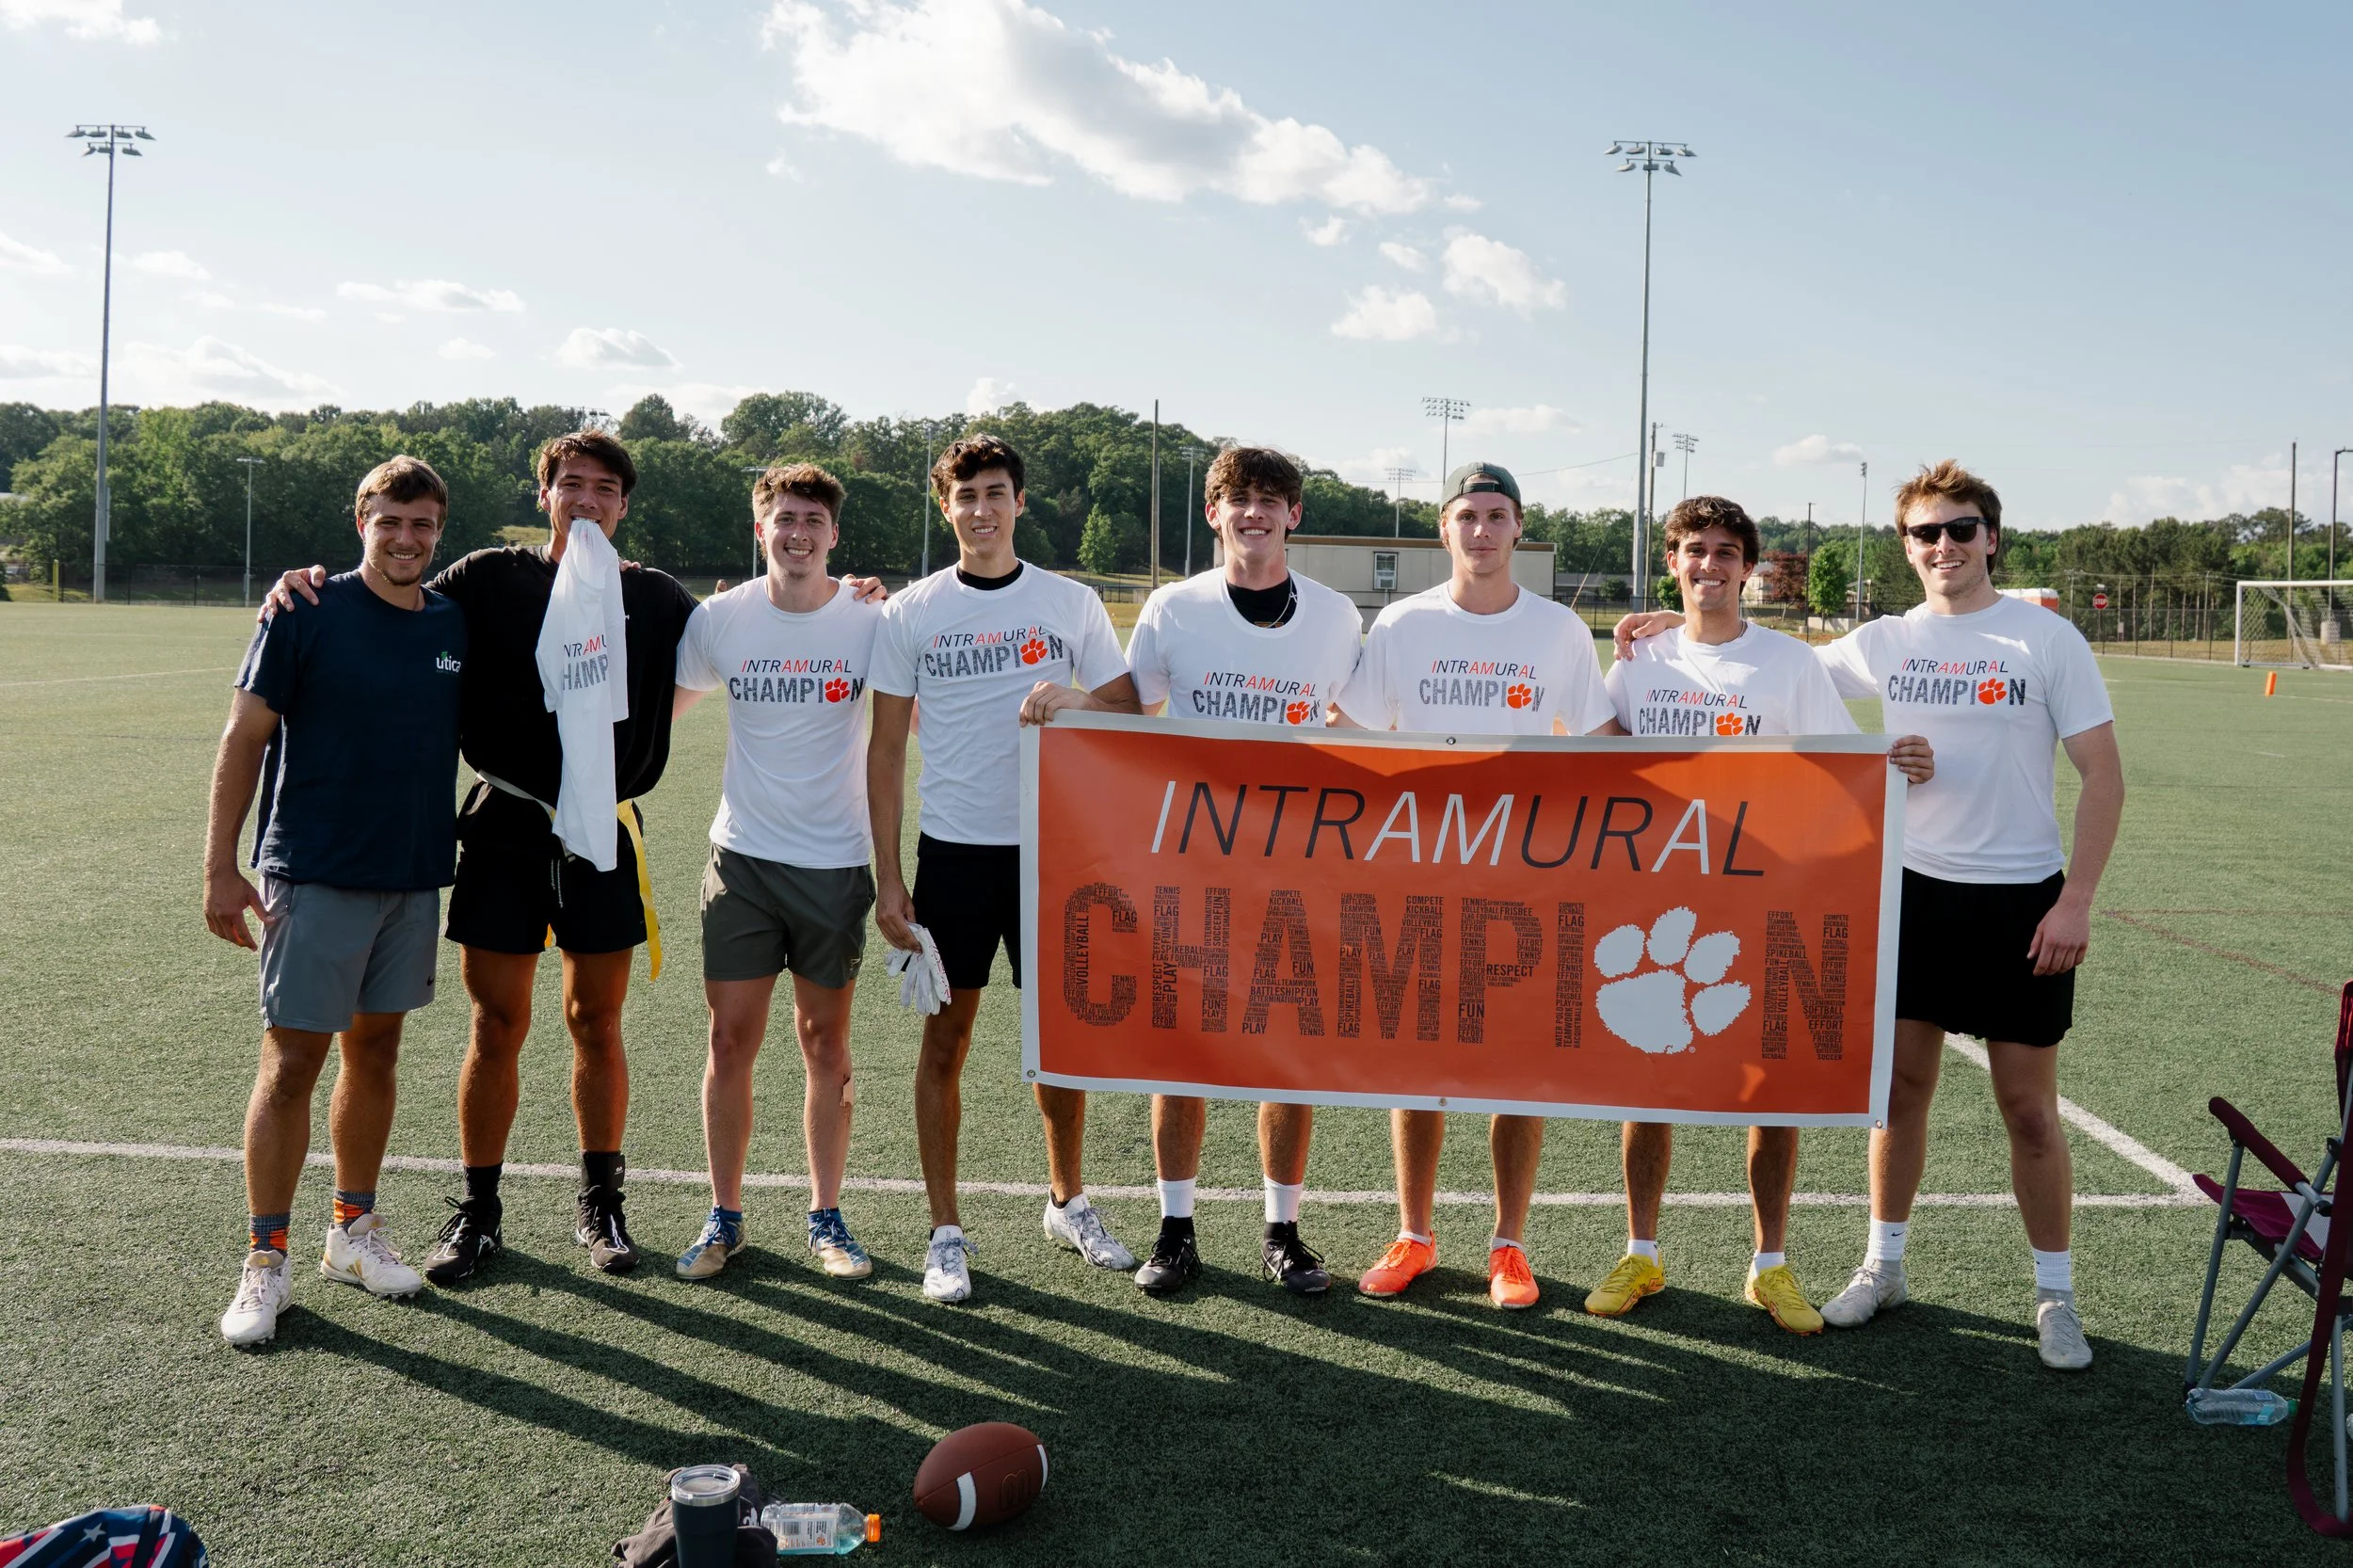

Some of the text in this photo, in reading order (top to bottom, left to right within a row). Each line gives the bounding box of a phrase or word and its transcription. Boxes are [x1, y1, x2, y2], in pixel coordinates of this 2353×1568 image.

[934, 625, 1048, 648] INTRAMURAL
[436, 655, 461, 673] utica
[741, 659, 853, 674] INTRAMURAL
[1901, 658, 2009, 675] INTRAMURAL
[1432, 660, 1537, 680] INTRAMURAL
[1204, 671, 1316, 697] INTRAMURAL
[1645, 689, 1748, 710] INTRAMURAL
[1150, 780, 1766, 878] INTRAMURAL
[1155, 887, 1180, 895] TENNIS
[1206, 888, 1230, 896] EFFORT
[1271, 889, 1302, 898] COMPETE
[1212, 896, 1224, 915] FUN
[1270, 896, 1304, 906] KICKBALL
[1406, 895, 1444, 905] COMPETE
[1462, 897, 1487, 906] TENNIS
[1154, 905, 1179, 917] FLAG
[1340, 904, 1377, 913] TEAMWORK
[1405, 904, 1443, 915] KICKBALL
[1461, 905, 1533, 917] VOLLEYBALL FRISBEE
[1112, 910, 1138, 923] FLAG
[1558, 914, 1584, 927] FLAG
[1768, 910, 1793, 920] EFFORT
[1205, 895, 1213, 947] DETERMINATION
[1401, 919, 1443, 928] VOLLEYBALL
[1213, 915, 1222, 947] SOCCER
[1365, 925, 1382, 936] FUN
[1420, 928, 1444, 939] FLAG
[1461, 924, 1487, 933] EFFORT
[1823, 927, 1849, 938] FLAG
[1153, 928, 1161, 953] EFFORT
[1161, 927, 1171, 943] FUN
[1261, 933, 1283, 943] PLAY
[1461, 937, 1486, 947] TENNIS
[1517, 937, 1544, 947] EFFORT
[1076, 916, 1089, 984] VOLLEYBALL
[1161, 945, 1204, 954] SPIKEBALL
[1339, 947, 1362, 958] PLAY
[1397, 946, 1416, 956] PLAY
[1765, 948, 1807, 959] SPIKEBALL
[1369, 952, 1386, 961] FLAG
[1460, 952, 1486, 960] FRISBEE
[1516, 951, 1543, 960] TENNIS
[1255, 961, 1278, 969] EFFORT
[1292, 961, 1314, 973] FUN
[1419, 964, 1442, 972] TENNIS
[1460, 959, 1485, 968] EFFORT
[1557, 963, 1583, 972] TENNIS
[1765, 958, 1779, 967] FUN
[1822, 961, 1847, 969] EFFORT
[1204, 966, 1228, 978] FLAG
[1254, 968, 1276, 979] FLAG
[1460, 967, 1485, 975] SOCCER
[1486, 963, 1534, 978] RESPECT
[1557, 971, 1582, 980] EFFORT
[1112, 975, 1137, 984] TENNIS
[1152, 963, 1162, 1002] RESPECT
[1162, 961, 1177, 993] PLAY
[1821, 974, 1847, 984] TENNIS
[1281, 979, 1317, 987] TEAMWORK
[1418, 979, 1441, 990] FLAG
[1778, 958, 1789, 1013] VOLLEYBALL
[1795, 980, 1817, 988] TENNIS
[1250, 986, 1318, 997] BATTLESHIP FUN
[1374, 988, 1404, 997] SOFTBALL
[1162, 993, 1177, 1002] FUN
[1248, 995, 1319, 1007] DETERMINATION PLAY
[1345, 979, 1355, 1023] SPIKEBALL
[1202, 999, 1221, 1010] FUN
[1376, 1001, 1402, 1010] EFFORT
[1458, 1002, 1485, 1018] FUN
[1202, 1009, 1221, 1018] PLAY
[1802, 1005, 1843, 1016] SOFTBALL
[1241, 1022, 1267, 1034] PLAY
[1337, 1022, 1360, 1033] FLAG
[1555, 1006, 1563, 1048] WATER POLO
[1563, 1007, 1573, 1048] TEAMWORK
[1573, 1006, 1582, 1049] RACQUETBALL
[1763, 1020, 1787, 1032] FLAG
[1808, 1018, 1844, 1030] EFFORT
[1300, 1027, 1325, 1036] TENNIS
[1381, 1031, 1396, 1040] FUN
